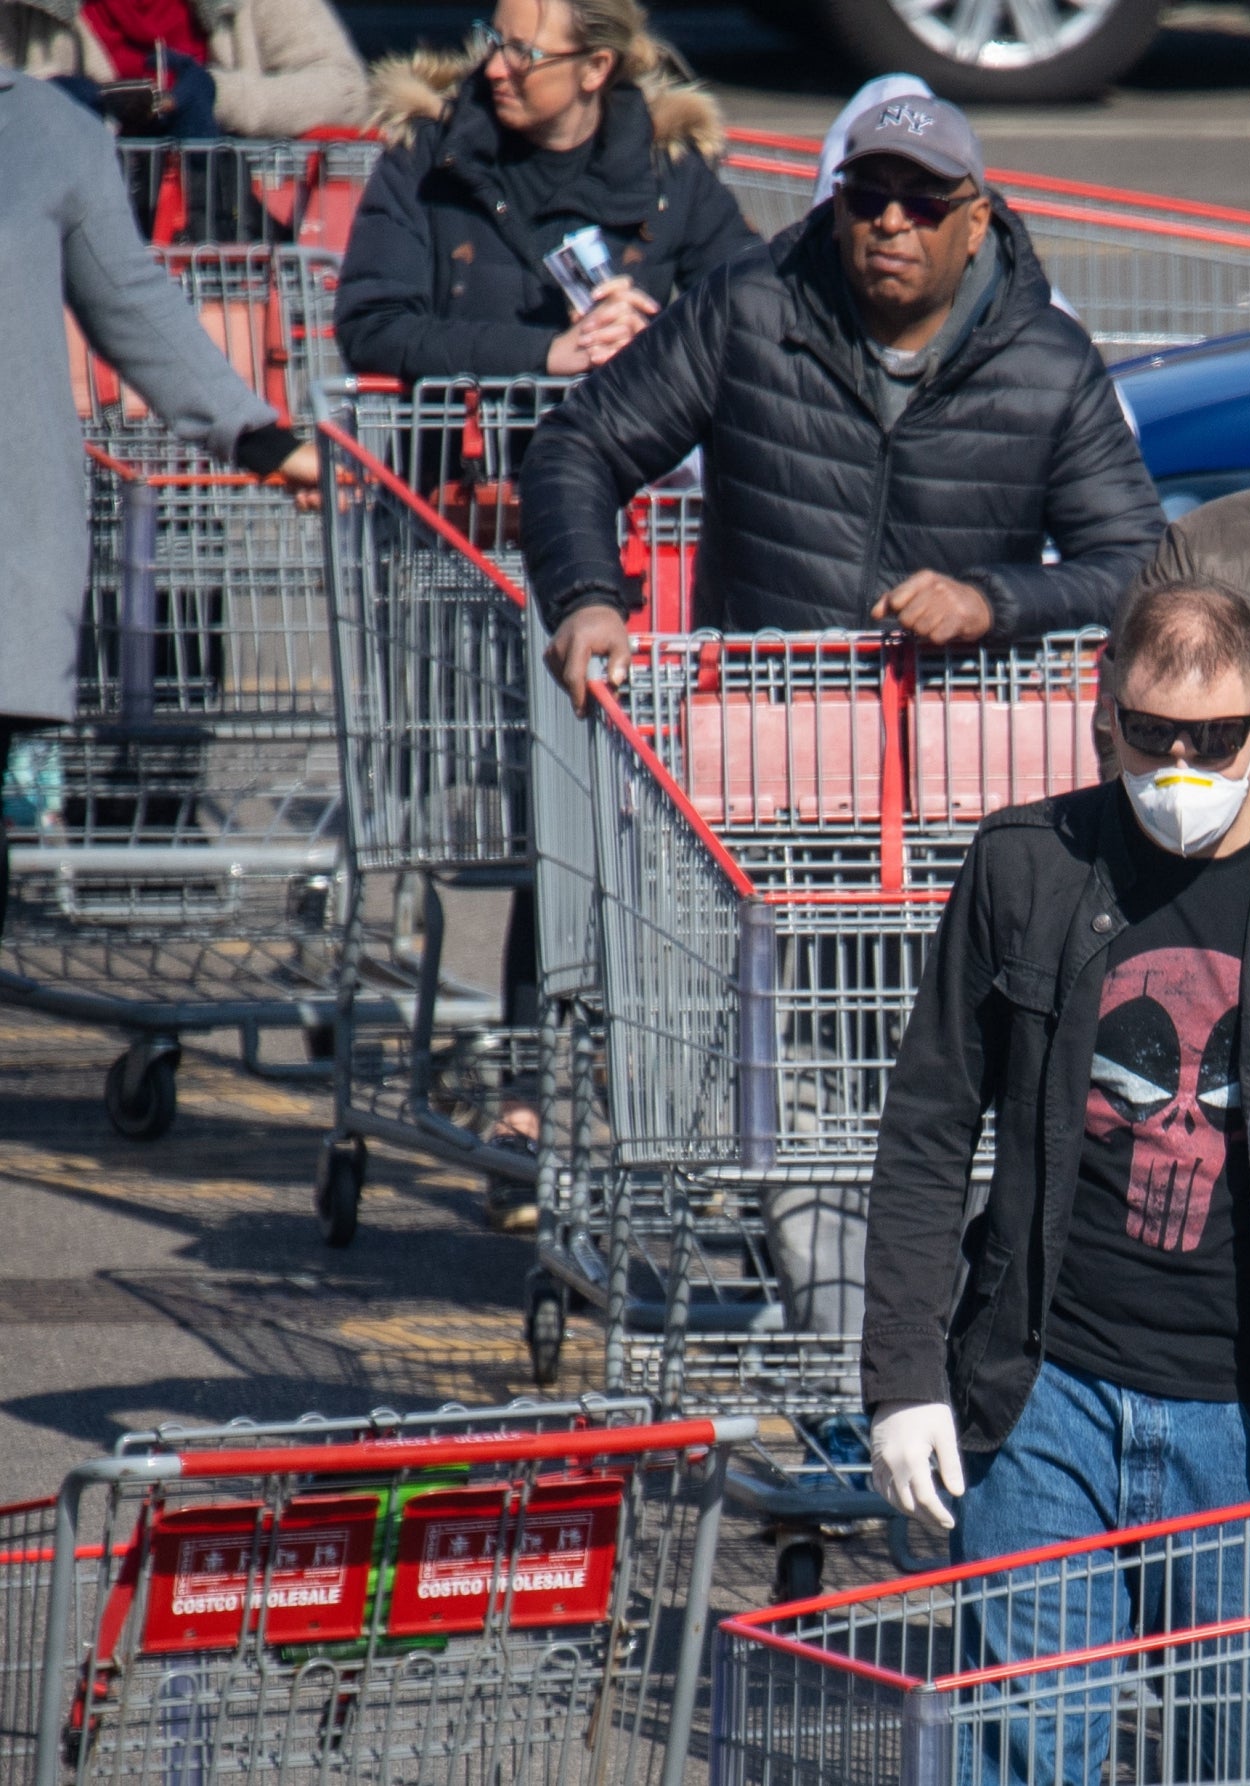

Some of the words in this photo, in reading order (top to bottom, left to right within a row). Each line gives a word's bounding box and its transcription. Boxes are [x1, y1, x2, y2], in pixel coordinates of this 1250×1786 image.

[876, 103, 934, 135] NY
[418, 1577, 483, 1599] COSTCO
[172, 1595, 238, 1616] COSTCO
